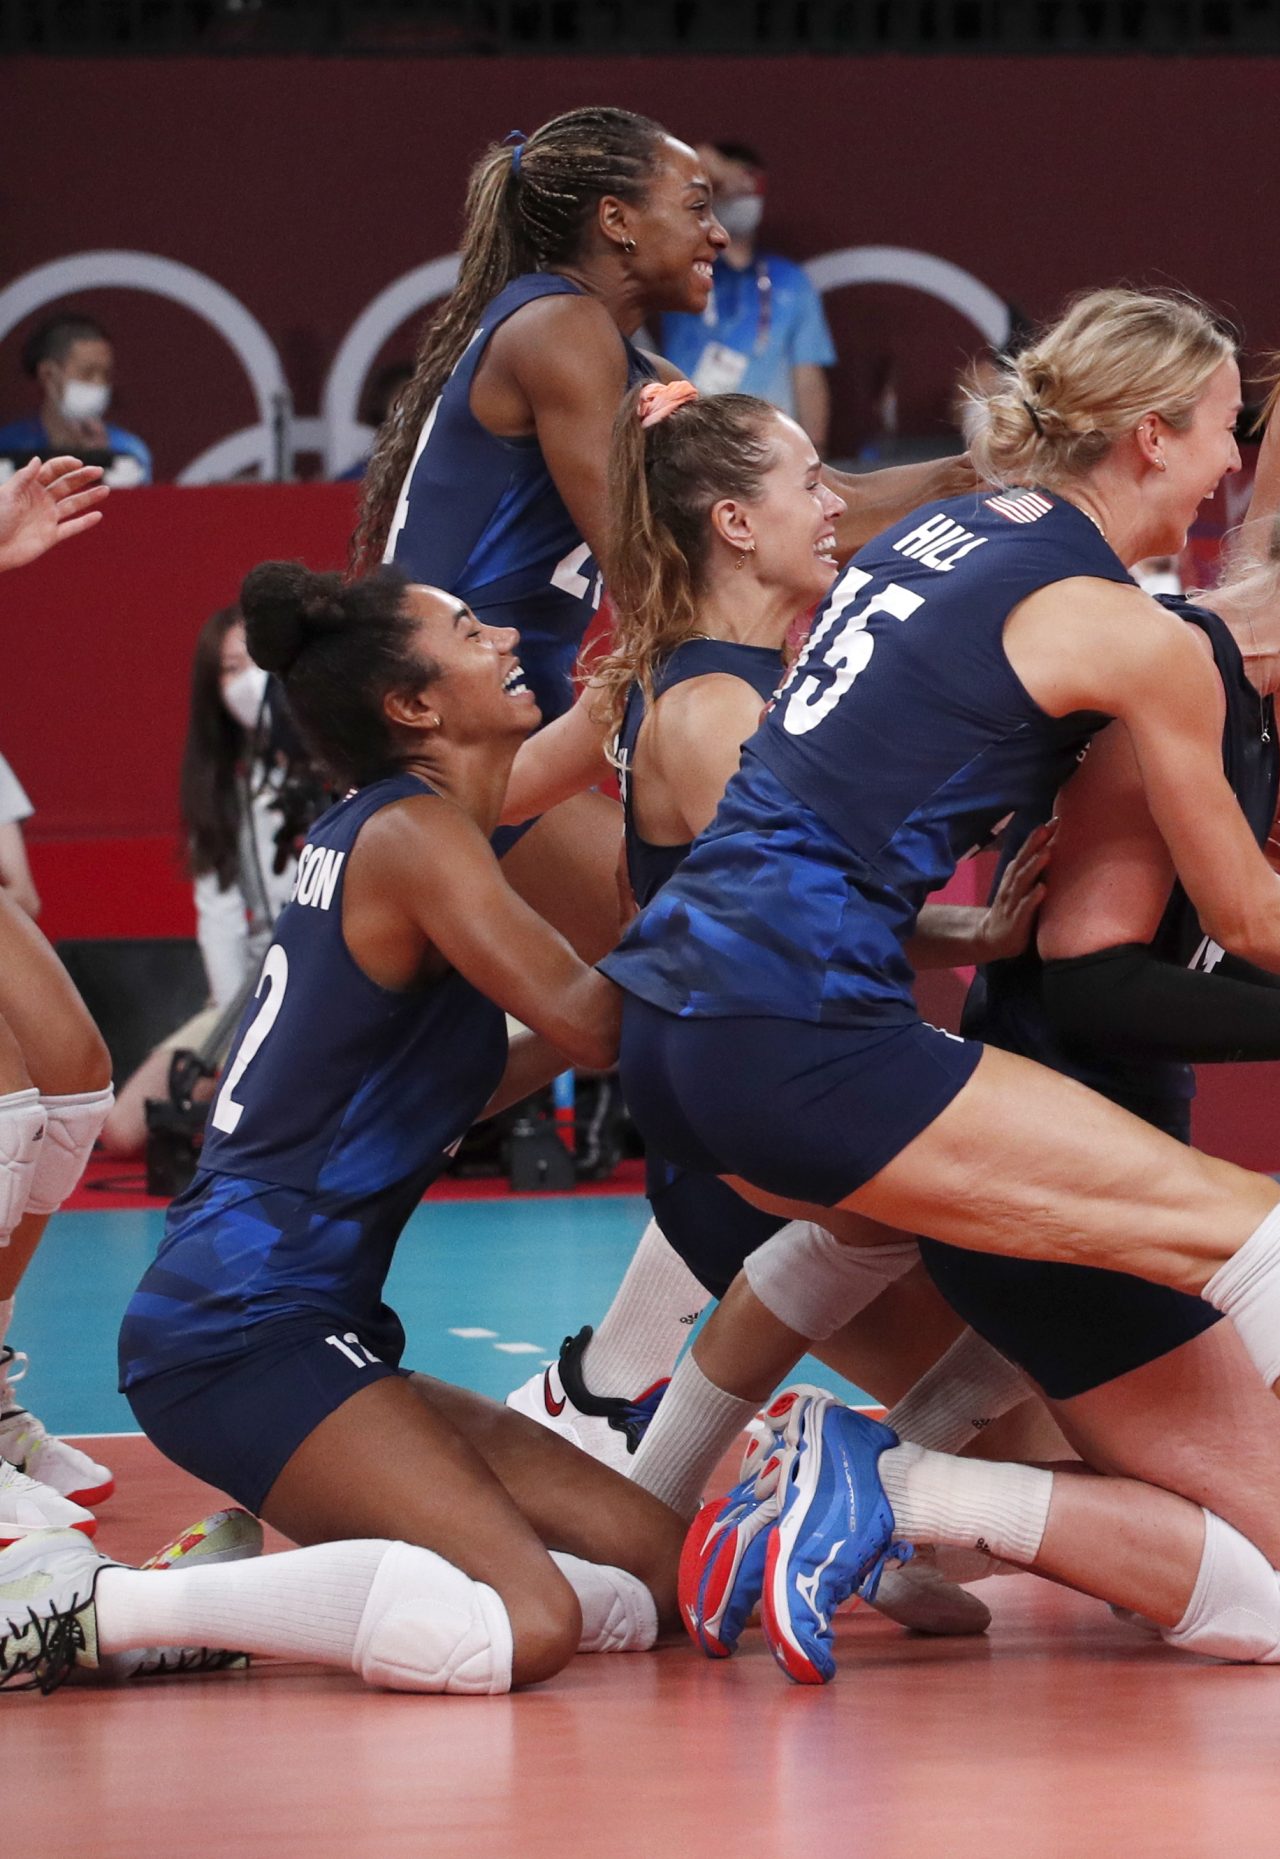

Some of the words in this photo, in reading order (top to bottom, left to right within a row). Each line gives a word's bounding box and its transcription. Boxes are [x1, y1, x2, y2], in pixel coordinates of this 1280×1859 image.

[892, 513, 988, 571] HILL
[773, 566, 926, 735] 15
[325, 1332, 383, 1368] 12
